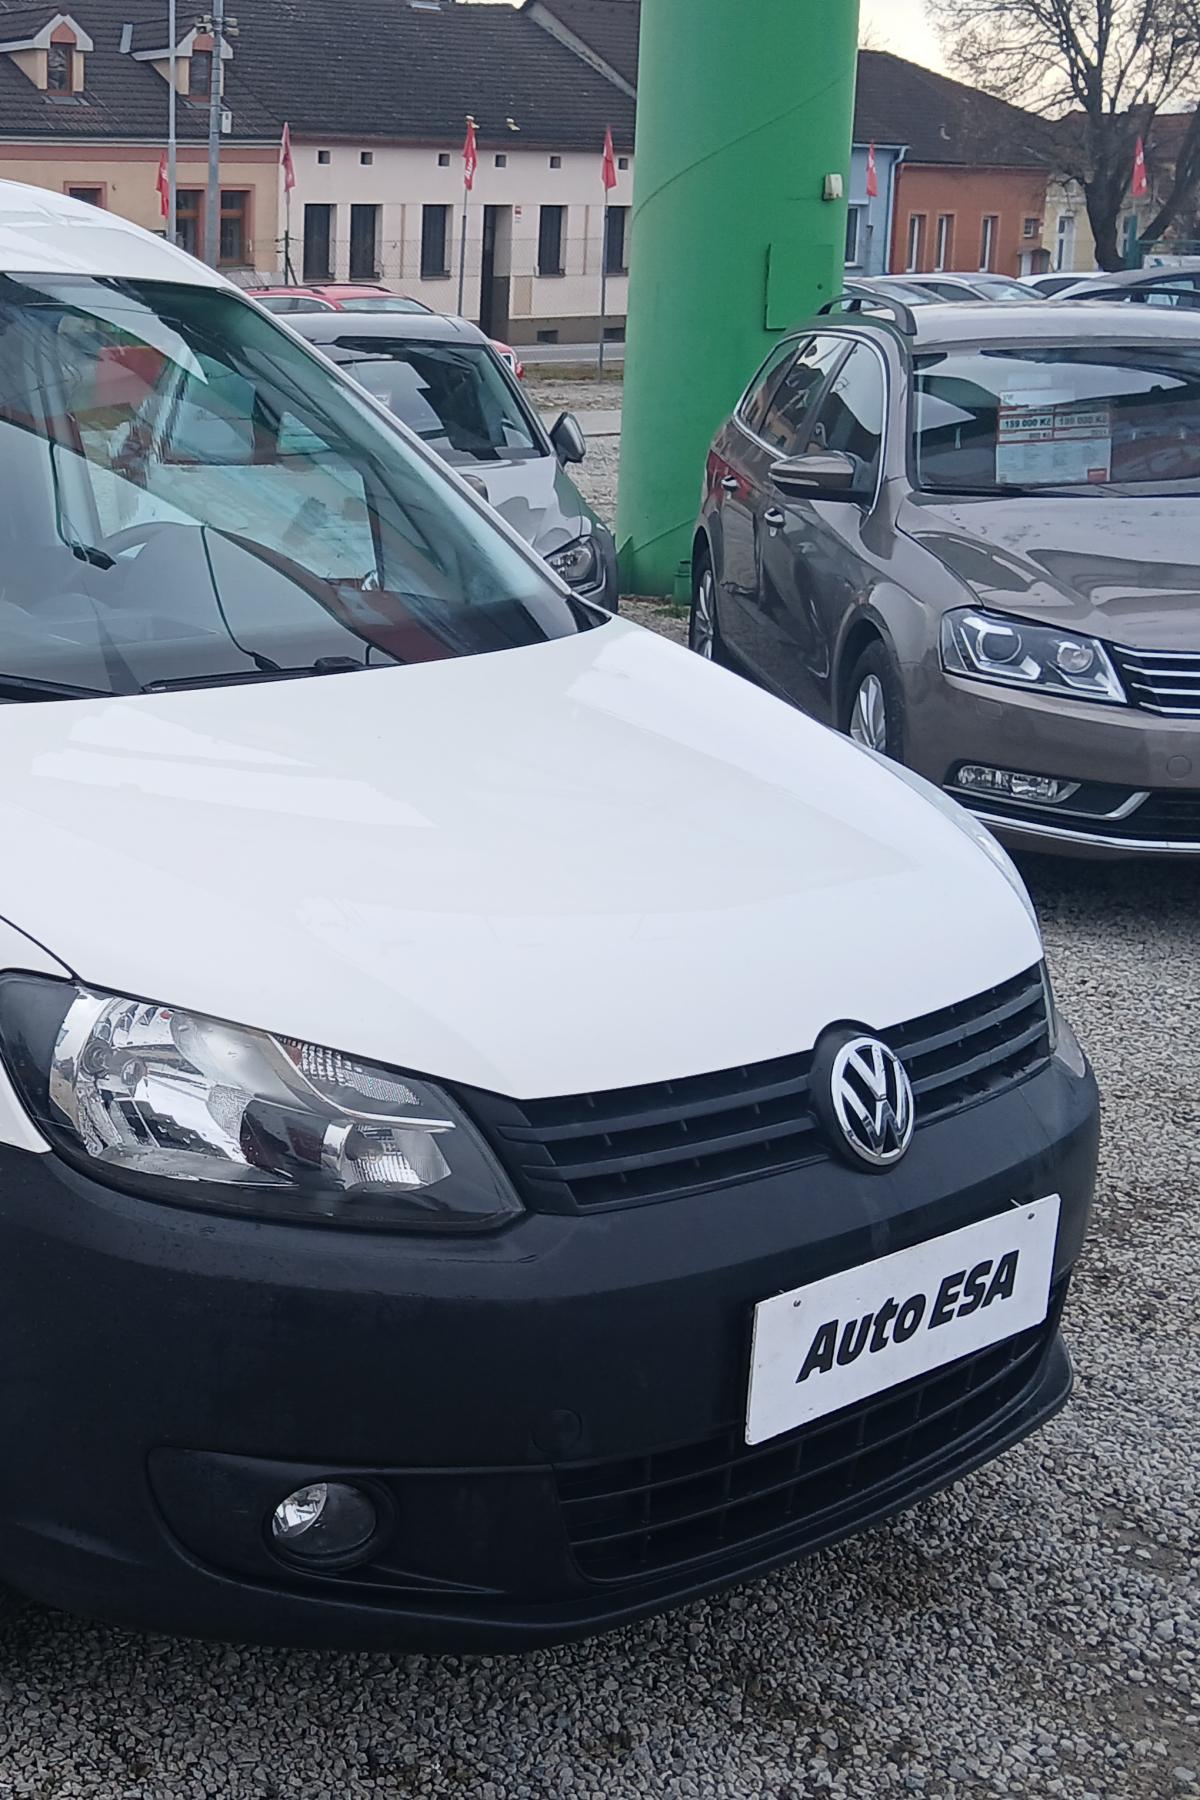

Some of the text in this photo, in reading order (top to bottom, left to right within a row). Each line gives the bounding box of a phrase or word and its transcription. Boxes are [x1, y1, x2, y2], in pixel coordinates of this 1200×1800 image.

[1022, 419, 1038, 428] 000
[796, 1250, 1019, 1384] Auto ESA
